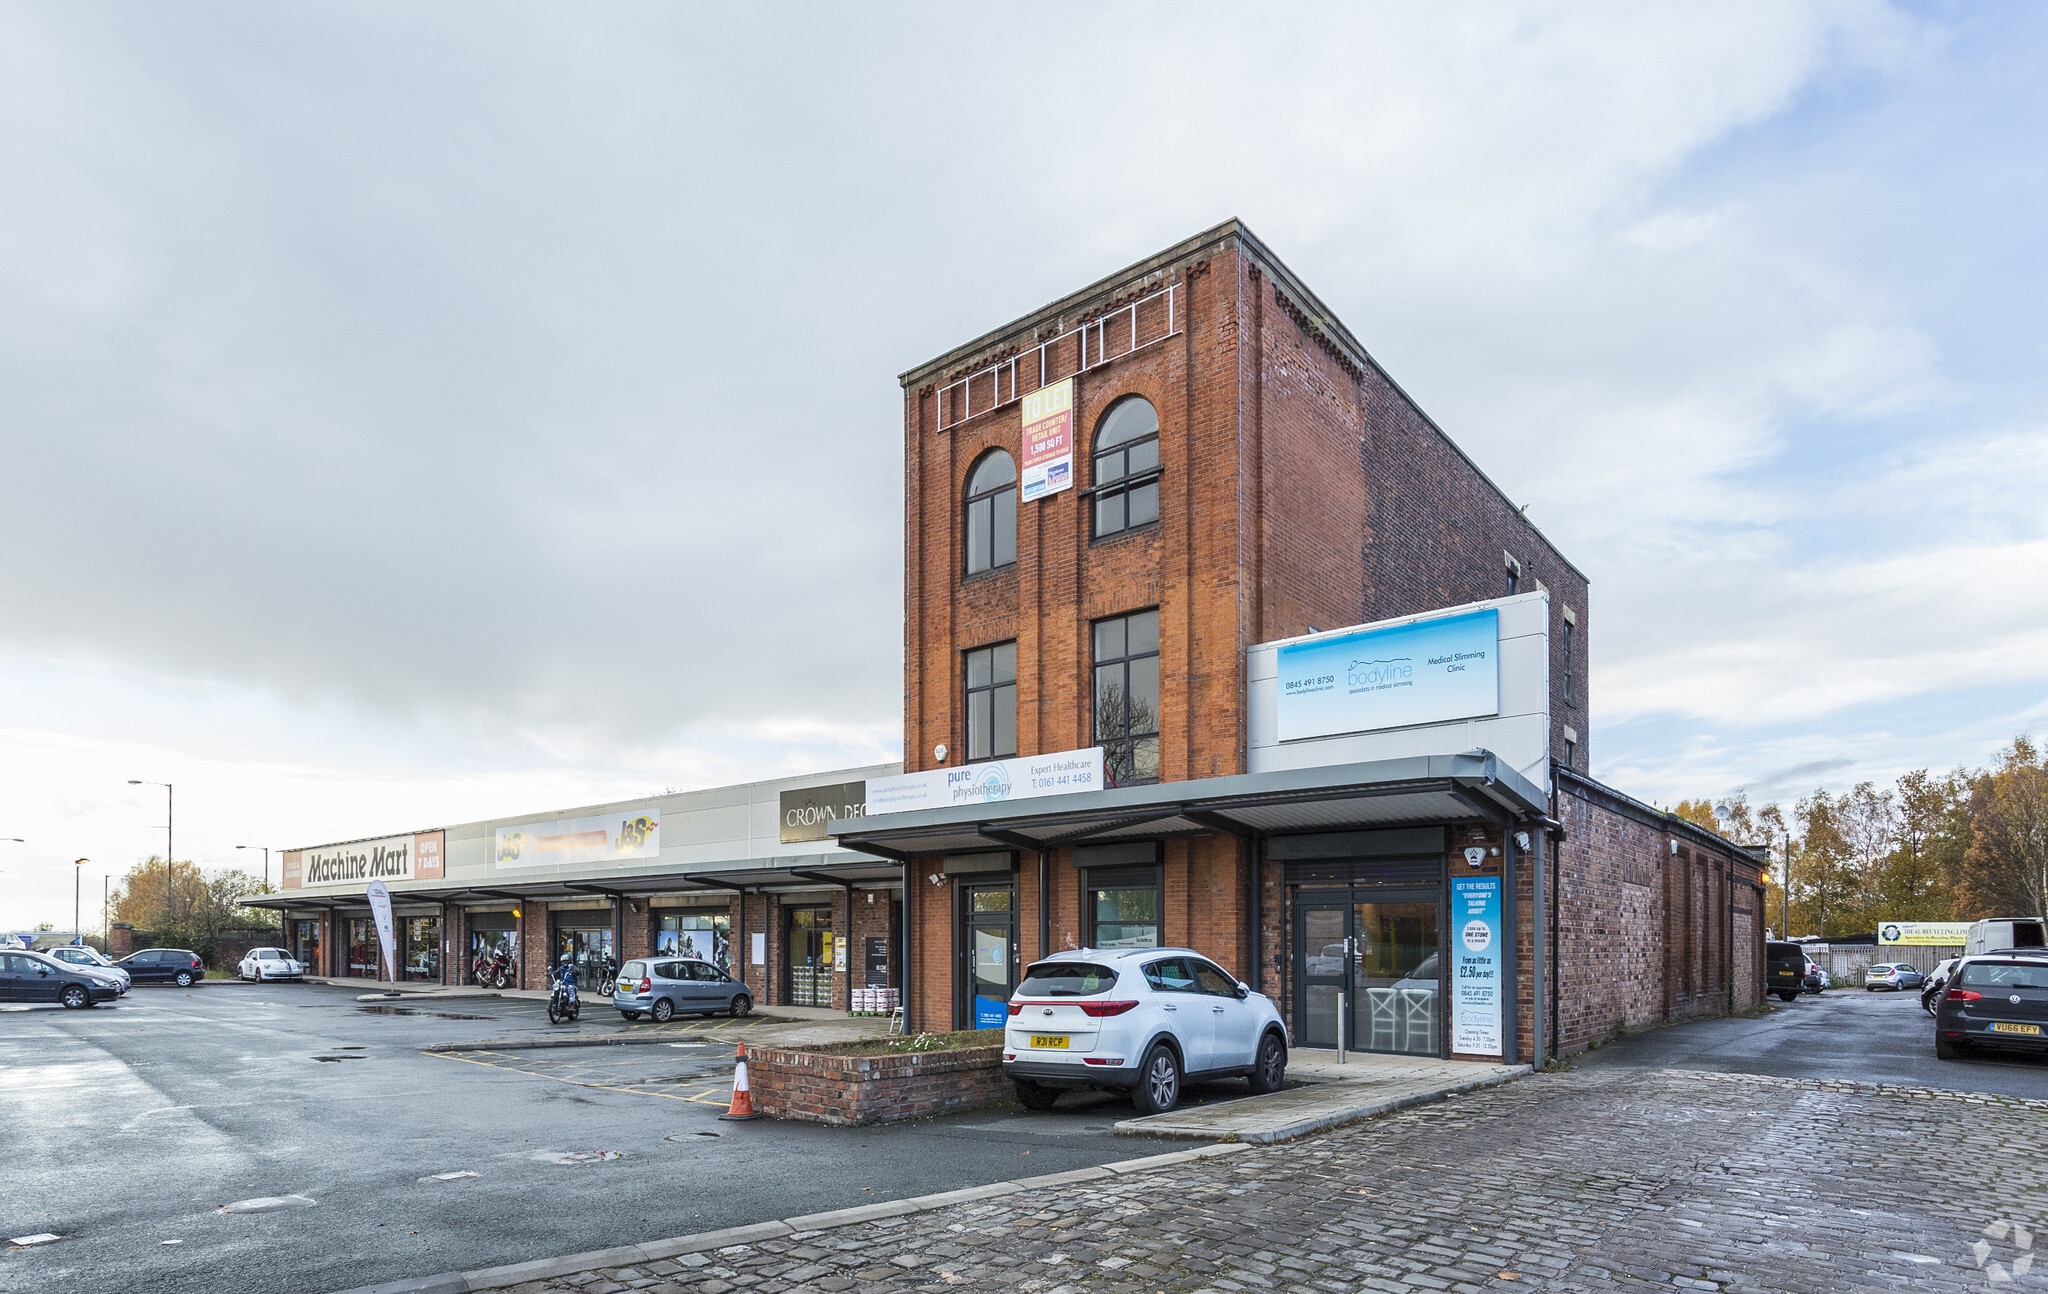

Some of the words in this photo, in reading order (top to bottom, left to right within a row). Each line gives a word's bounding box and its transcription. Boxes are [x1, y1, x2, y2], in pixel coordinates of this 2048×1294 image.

[1024, 396, 1041, 422] TO
[1045, 384, 1068, 414] LET
[1026, 422, 1042, 437] TRADE
[1032, 429, 1048, 443] RETAIL
[1049, 425, 1062, 437] UNIT
[1047, 438, 1055, 450] SQ
[1056, 435, 1063, 446] FT
[1428, 654, 1452, 666] Medical
[1454, 649, 1485, 662] Slimming
[1348, 664, 1412, 687] bodyline
[1447, 663, 1466, 674] Clinic
[1286, 680, 1302, 690] 0845
[1304, 678, 1314, 687] 491
[1317, 675, 1334, 684] 8750
[1393, 680, 1413, 688] slimming
[1030, 764, 1052, 777] Expert
[1053, 760, 1092, 772] Healthcare
[948, 769, 971, 787] pure
[1038, 777, 1055, 788] 0161
[1056, 775, 1070, 787] 441
[1072, 772, 1092, 785] 4458
[952, 780, 1012, 802] physiotherapy
[786, 804, 836, 827] CROWN
[420, 840, 437, 854] OPEN
[308, 851, 367, 883] Machine
[369, 843, 408, 878] Mart
[418, 858, 423, 870] 7
[424, 856, 440, 869] DAYS
[1466, 882, 1474, 890] THE
[1476, 882, 1496, 890] RESULTS
[1462, 956, 1472, 964] From
[1460, 966, 1476, 978] £2.50
[1996, 1023, 2018, 1032] VU66
[2020, 1025, 2038, 1033] EFY
[1049, 1037, 1063, 1046] RCP
